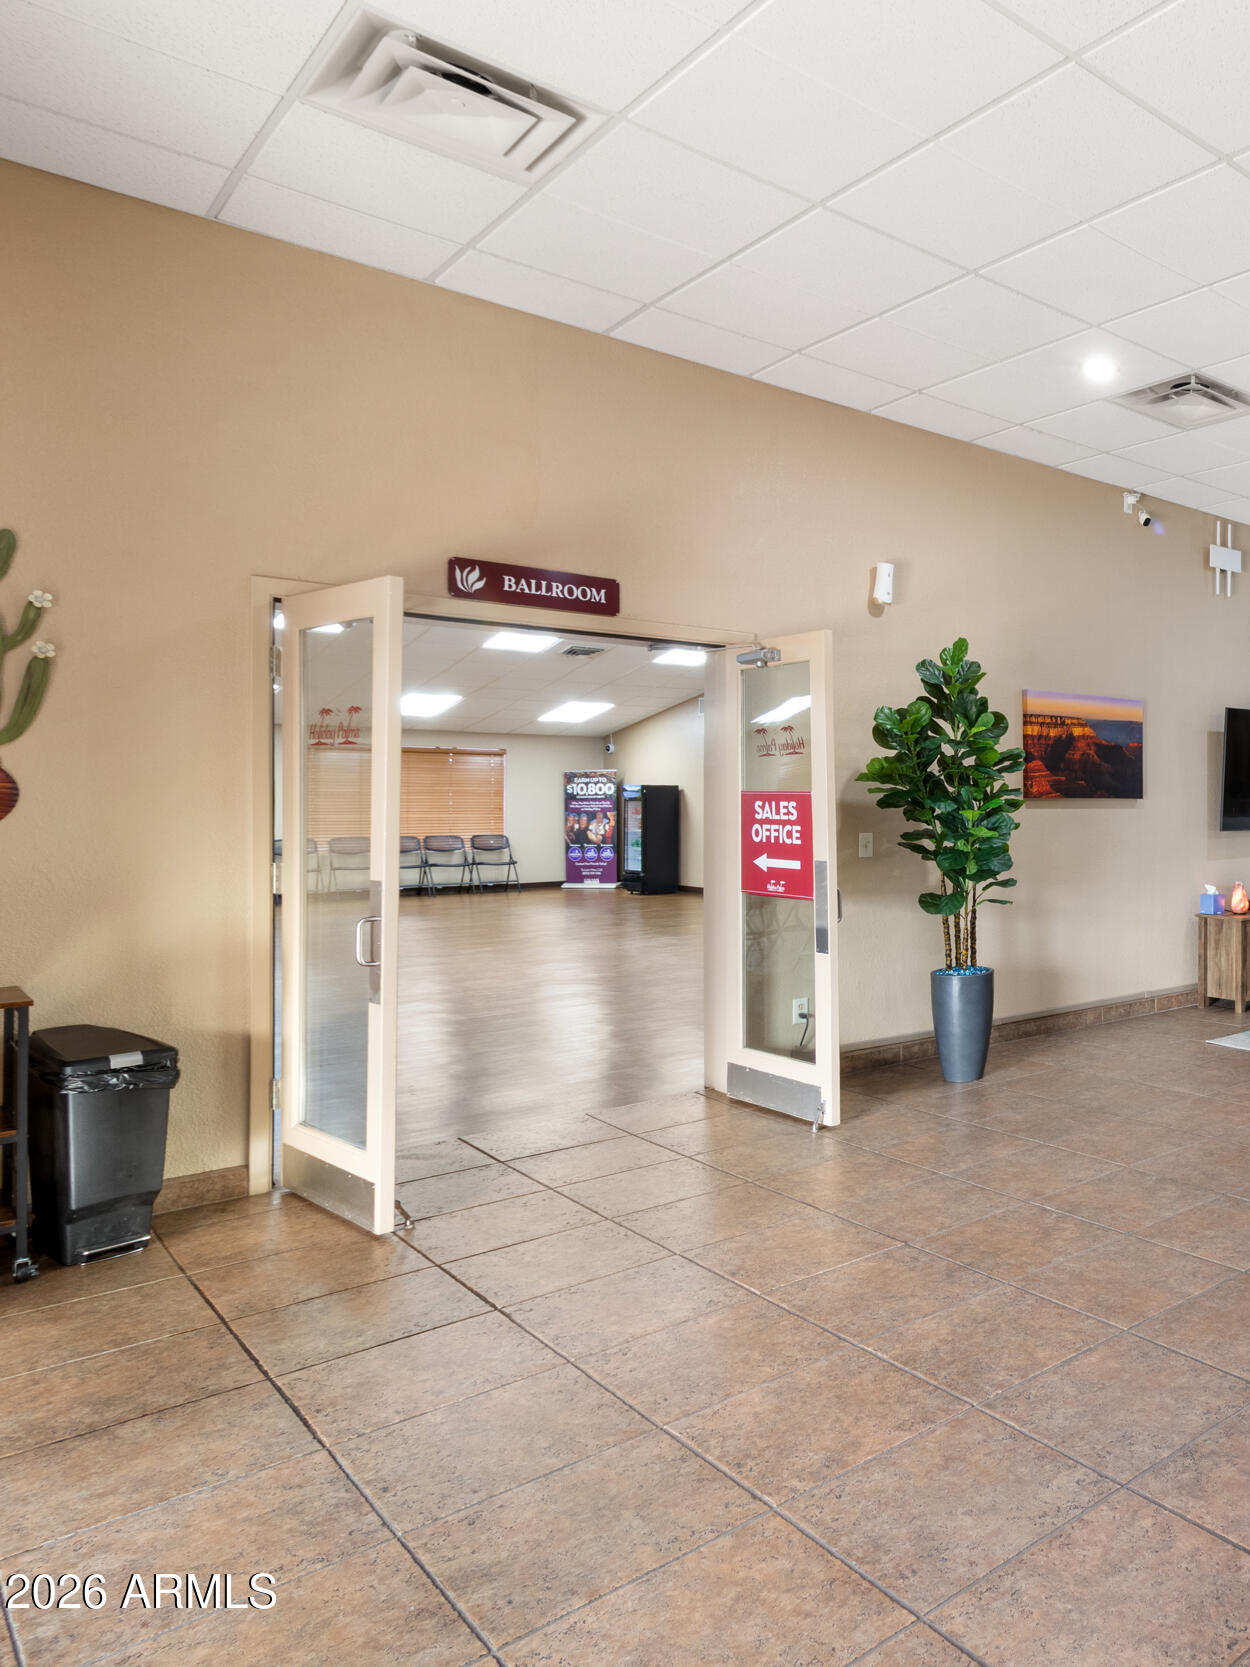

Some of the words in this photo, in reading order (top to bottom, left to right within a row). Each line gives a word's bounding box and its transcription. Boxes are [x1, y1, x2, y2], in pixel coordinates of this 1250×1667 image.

[502, 575, 607, 604] BALLROOM
[566, 783, 615, 795] $10,800
[754, 800, 798, 821] SALES
[751, 824, 802, 844] OFFICE
